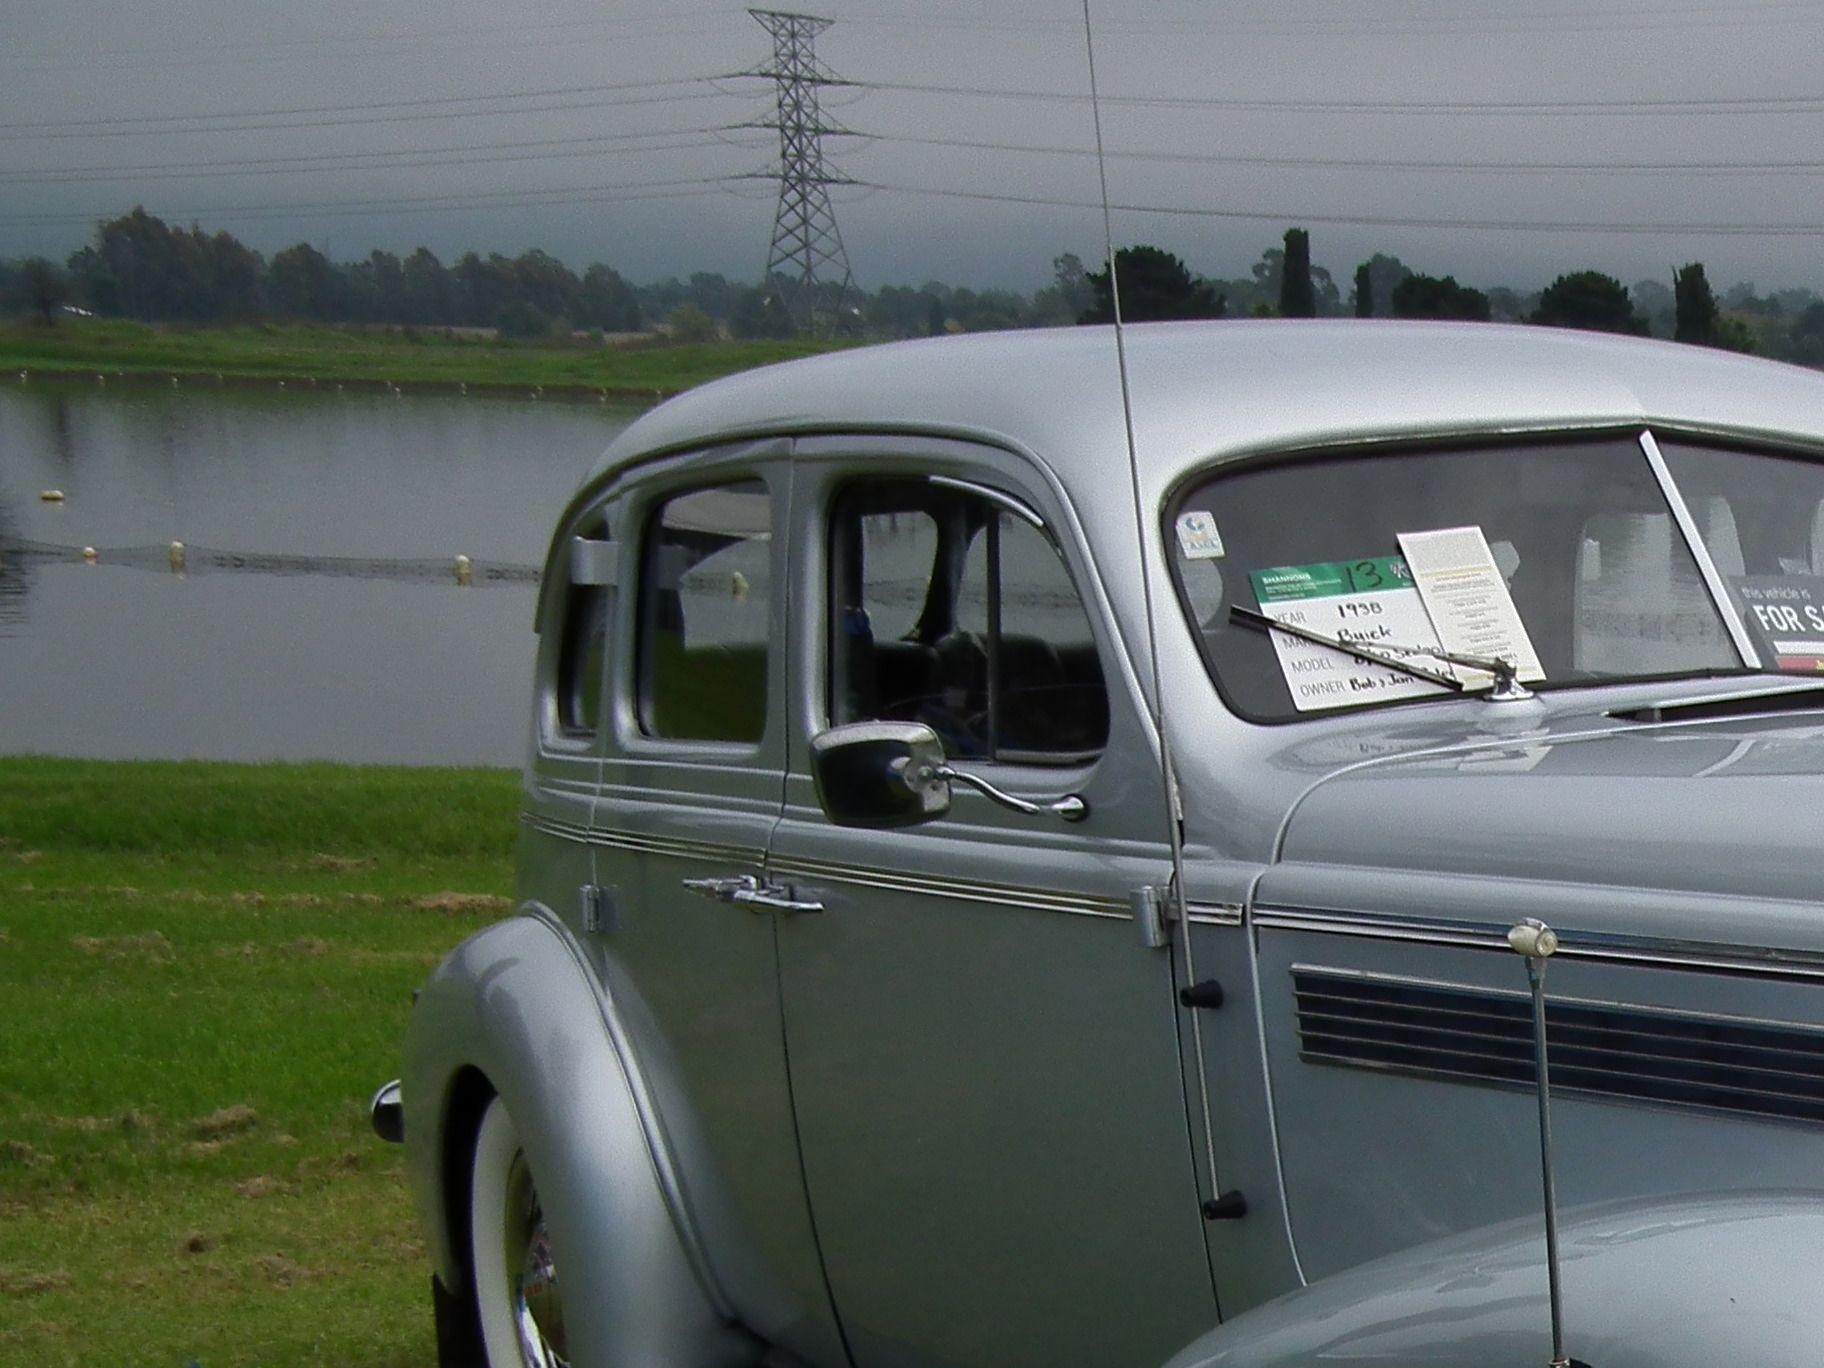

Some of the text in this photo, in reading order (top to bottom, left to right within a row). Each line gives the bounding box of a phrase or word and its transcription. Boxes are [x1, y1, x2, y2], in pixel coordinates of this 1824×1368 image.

[1346, 561, 1383, 594] 13
[1764, 586, 1800, 599] vehicle
[1274, 612, 1307, 624] YEAR
[1338, 603, 1382, 618] 1938
[1753, 605, 1806, 632] FOR
[1337, 625, 1392, 642] Buick
[1291, 658, 1335, 673] MODEL
[1300, 681, 1345, 697] OWNER
